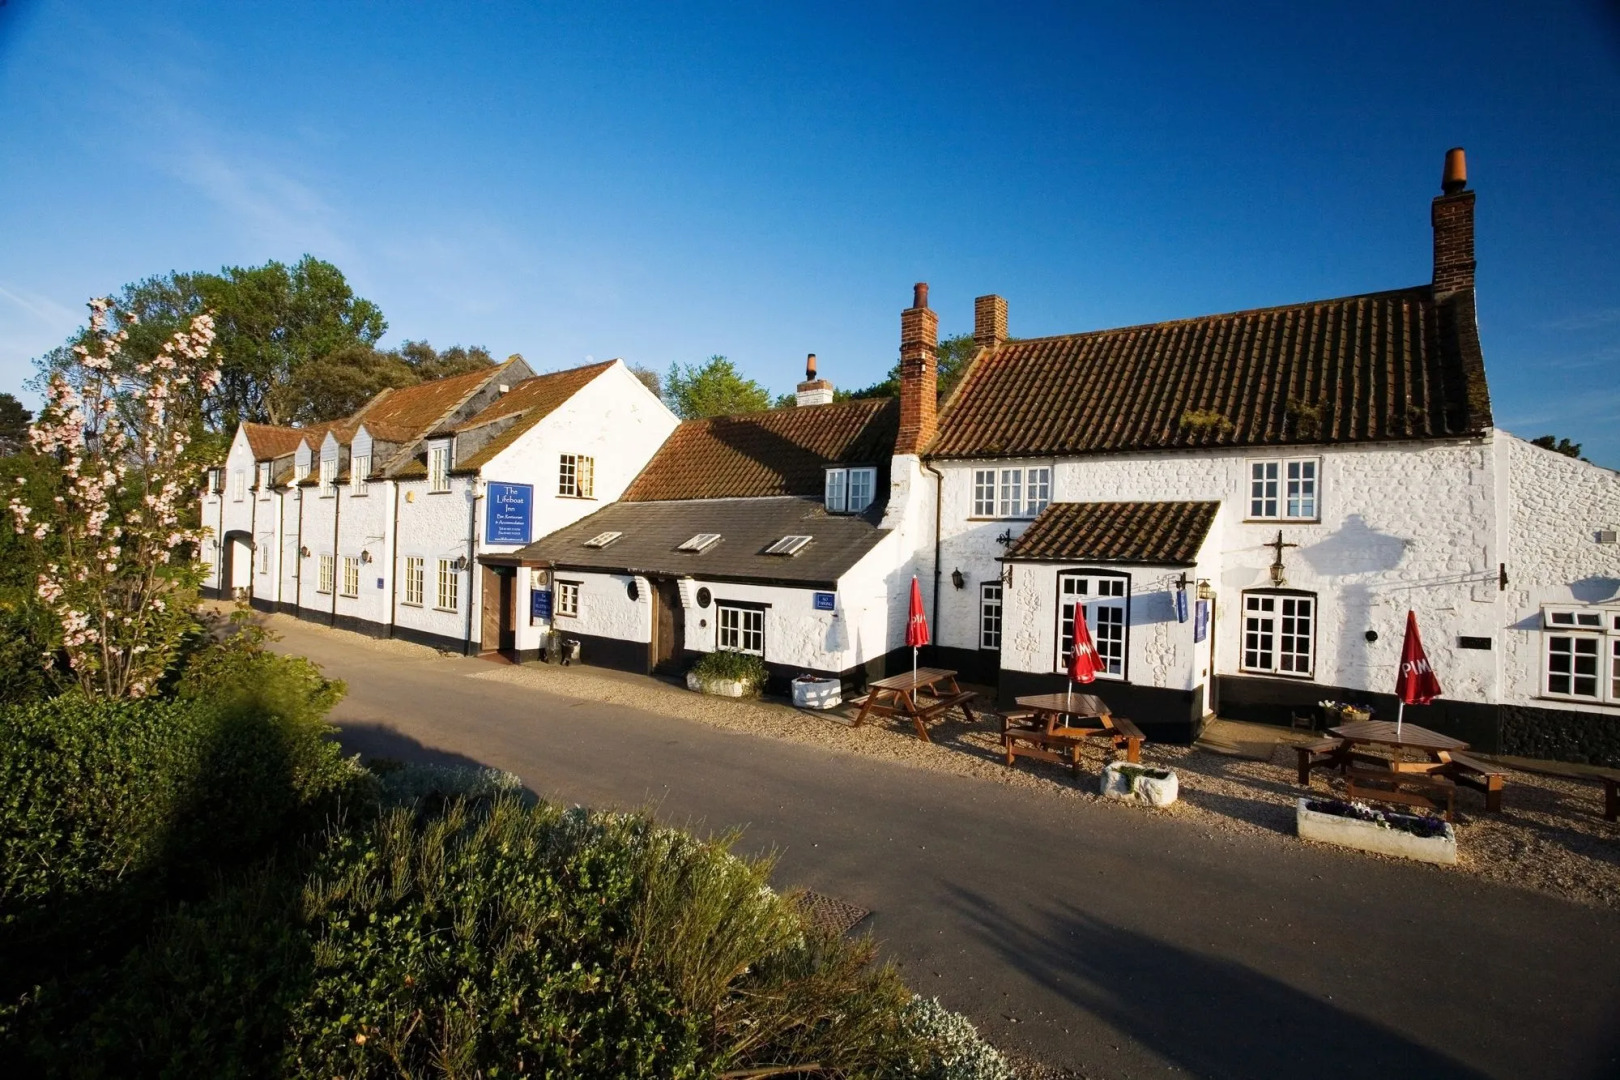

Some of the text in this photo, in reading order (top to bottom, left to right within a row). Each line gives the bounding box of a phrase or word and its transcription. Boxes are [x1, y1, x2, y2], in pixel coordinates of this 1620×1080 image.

[504, 487, 518, 495] The
[496, 495, 524, 504] Lifeboat
[505, 504, 516, 513] Inn
